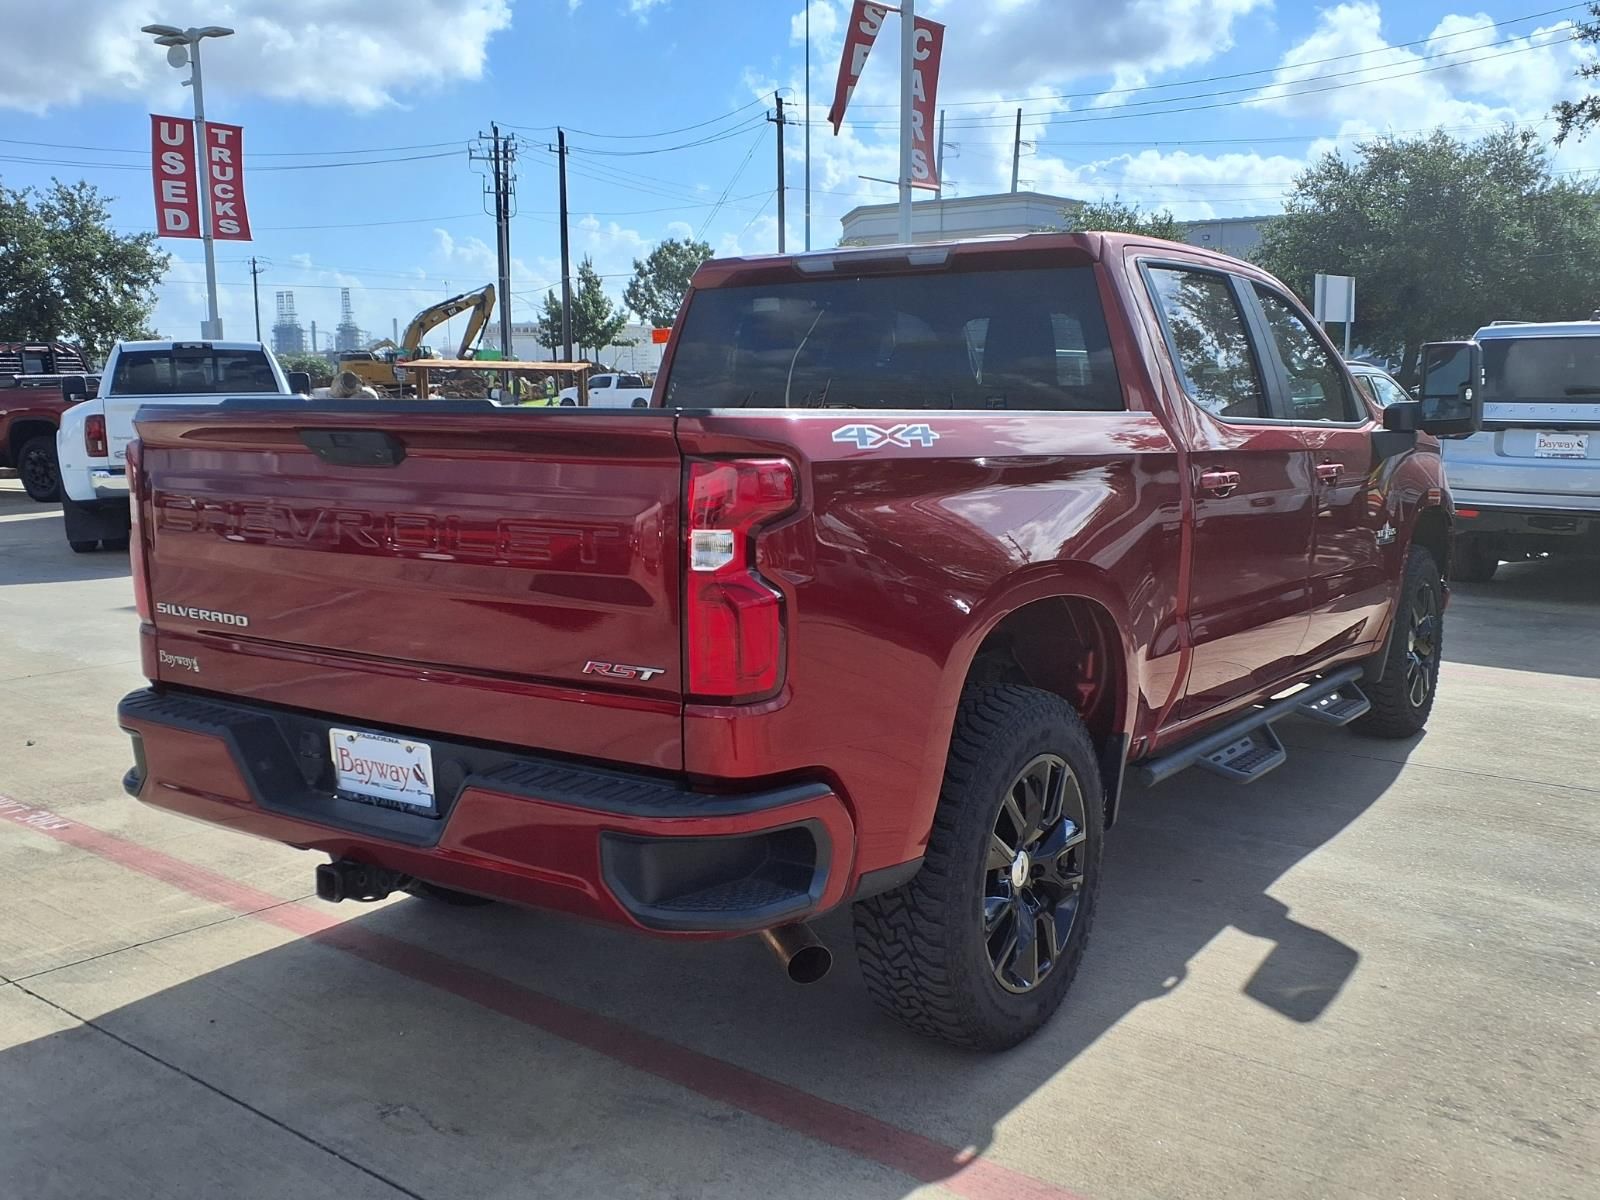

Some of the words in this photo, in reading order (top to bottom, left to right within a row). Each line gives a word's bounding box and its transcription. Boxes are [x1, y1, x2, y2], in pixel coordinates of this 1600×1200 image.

[912, 28, 934, 180] CARS
[160, 121, 190, 231] USED
[211, 128, 241, 234] TRUCKS
[1538, 438, 1576, 450] Bayway
[155, 493, 620, 565] CHEVROLET
[156, 602, 249, 627] SILVERADO
[159, 649, 197, 671] Bayway
[582, 660, 665, 681] RST
[337, 746, 410, 792] Bayway
